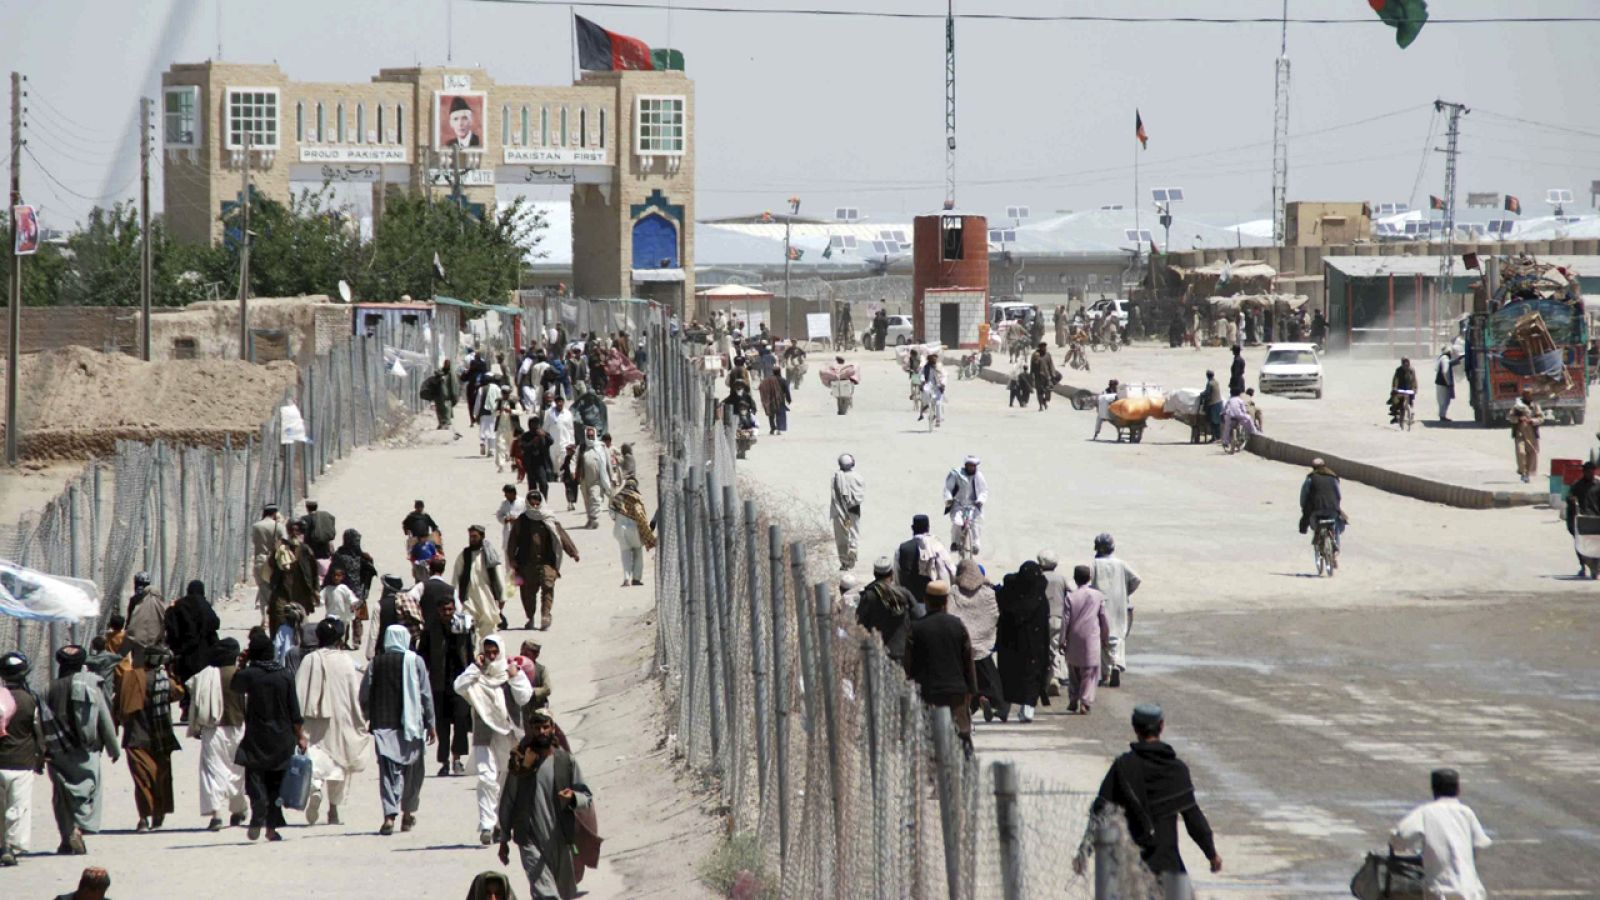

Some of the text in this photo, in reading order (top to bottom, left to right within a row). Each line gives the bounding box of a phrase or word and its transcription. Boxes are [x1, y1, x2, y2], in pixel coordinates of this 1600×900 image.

[303, 150, 339, 158] PROUD
[507, 151, 604, 161] PAKISTAN FIRST
